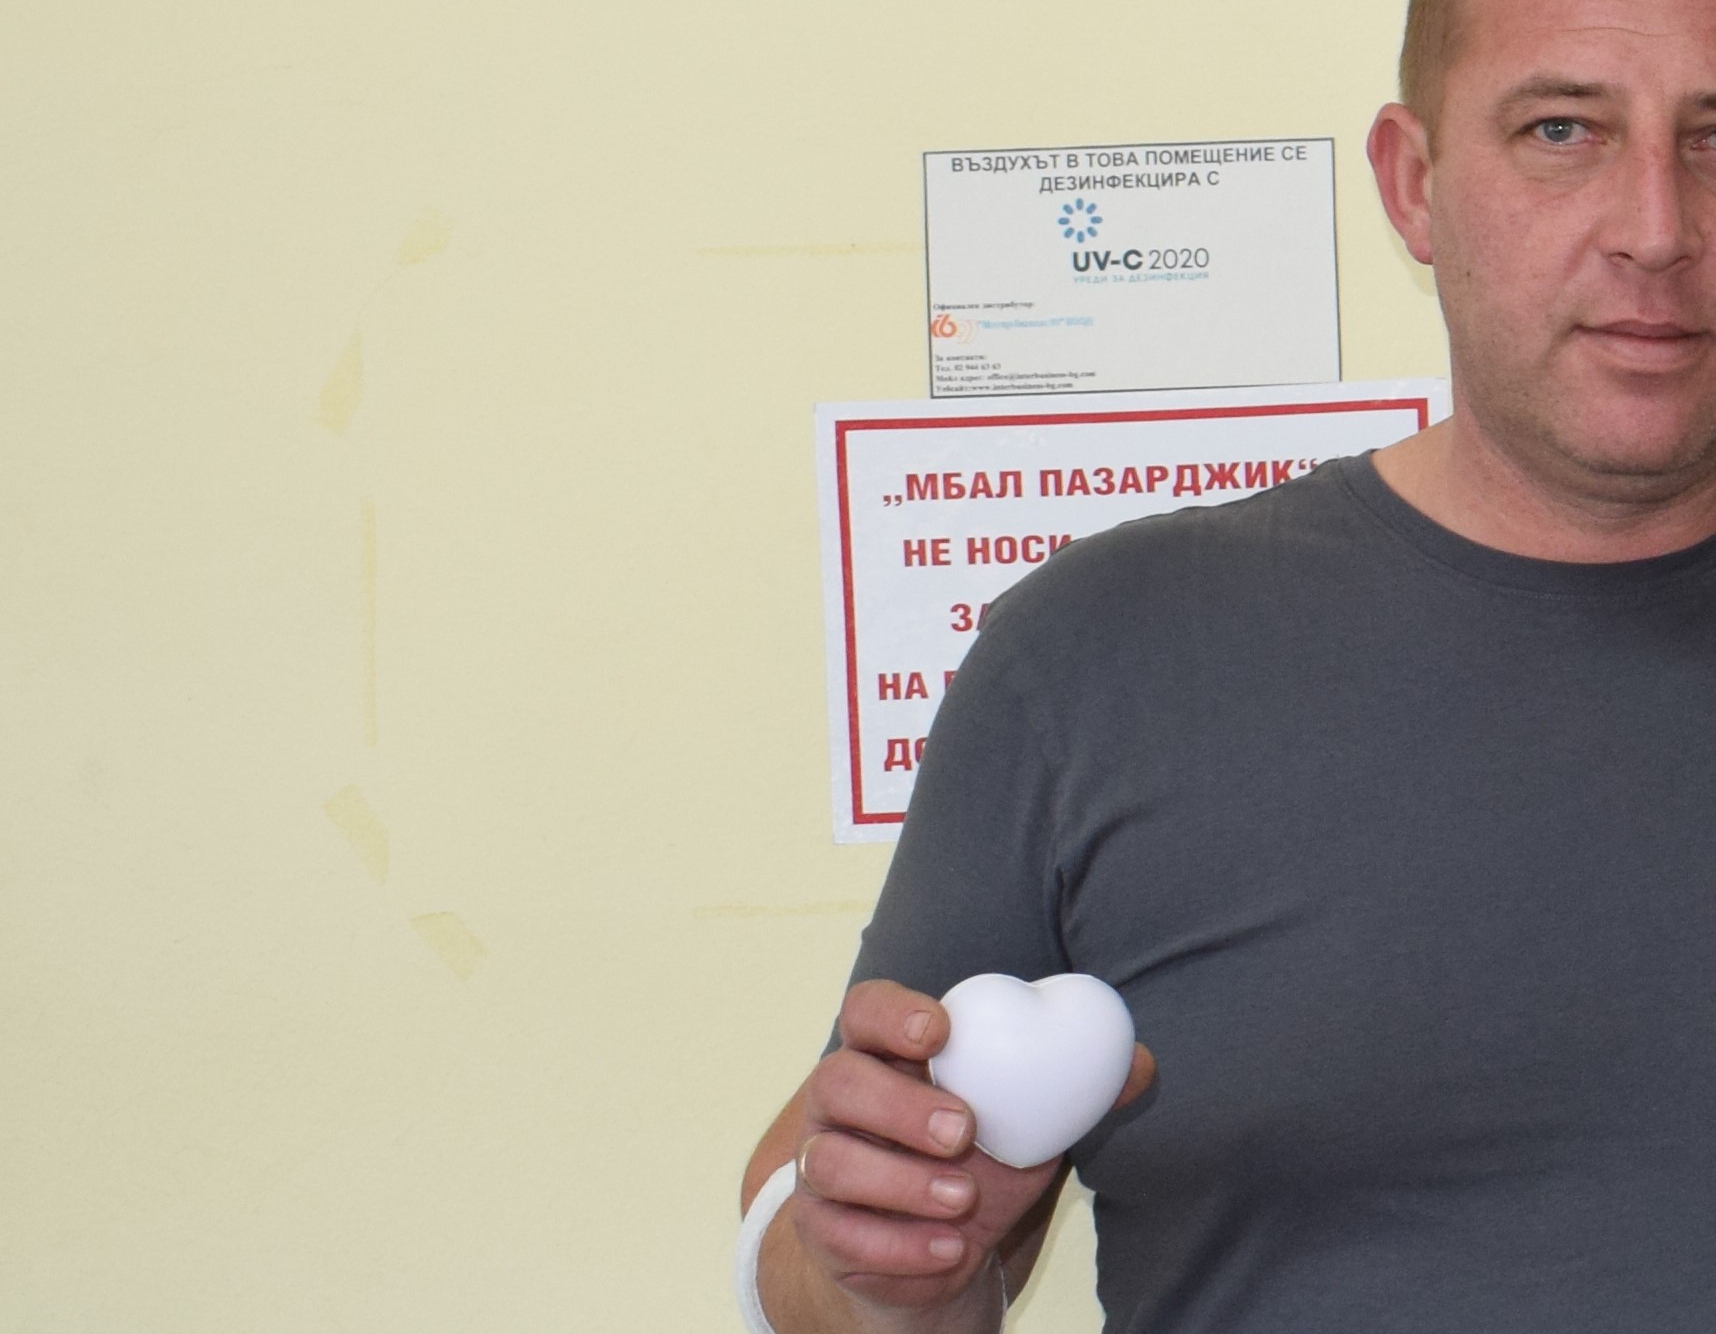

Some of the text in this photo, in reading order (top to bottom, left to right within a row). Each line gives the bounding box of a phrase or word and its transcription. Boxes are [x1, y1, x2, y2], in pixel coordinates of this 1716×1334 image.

[951, 145, 1308, 173] ВЪЗДУХЪТ В ТОВА ПОМЕЩЕНИЕ СЕ
[1039, 171, 1220, 194] ДЕЗИНФЕКЦИРА С
[1072, 248, 1210, 272] UV-C 2020
[882, 458, 1318, 507] „МБАЛ ПАЗАРДЖИК“
[903, 537, 952, 567] НЕ
[878, 670, 929, 700] НА
